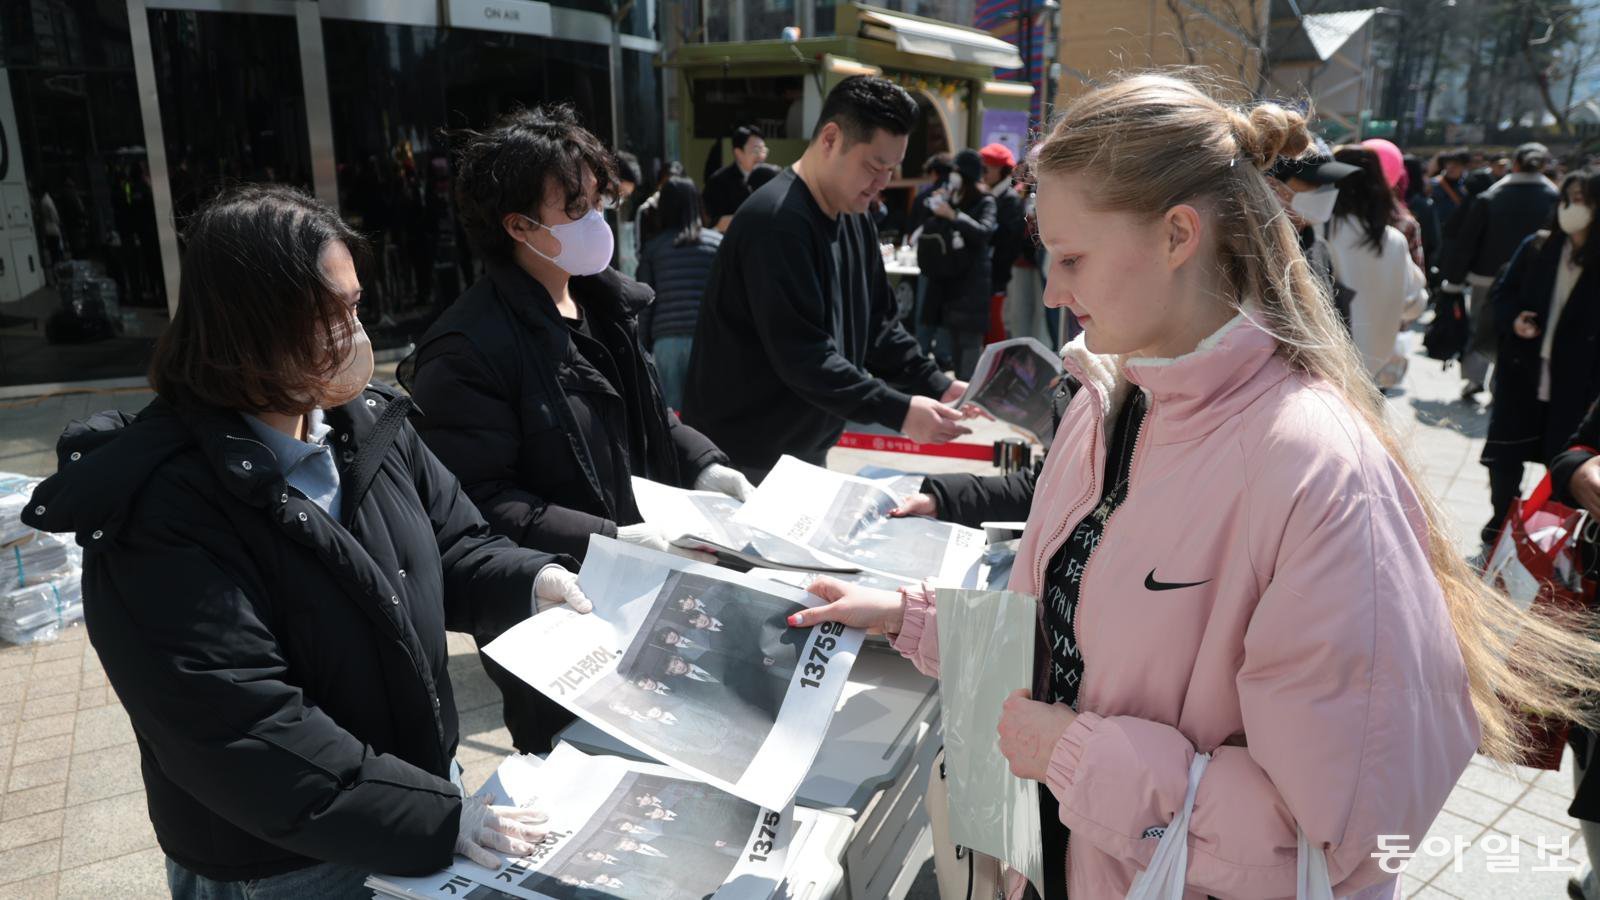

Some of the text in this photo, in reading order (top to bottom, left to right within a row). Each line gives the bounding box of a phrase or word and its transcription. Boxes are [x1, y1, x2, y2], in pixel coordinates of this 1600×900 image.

[484, 6, 520, 20] ON AIR
[549, 646, 623, 695] 기다렸어,
[800, 621, 846, 688] 1375일
[749, 812, 780, 862] 1375
